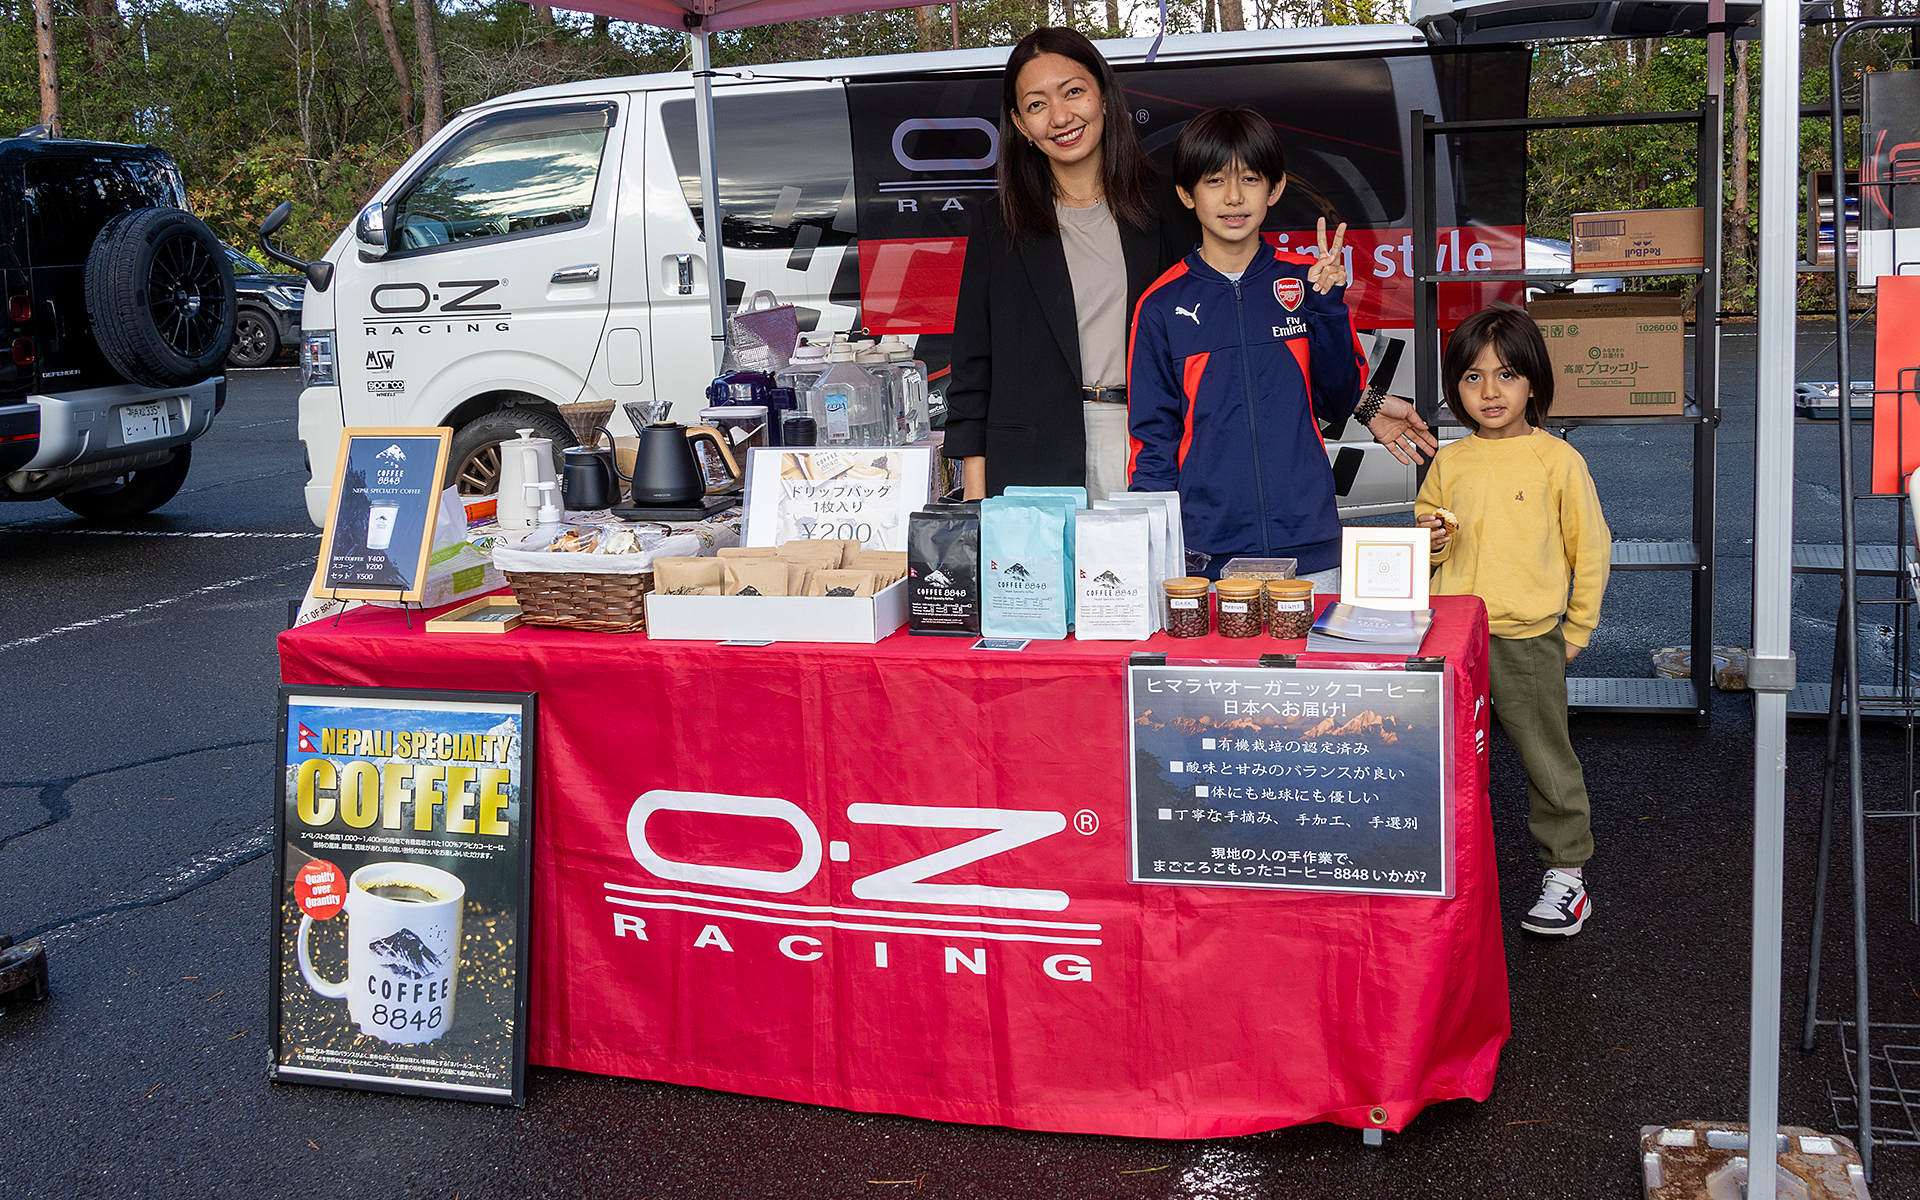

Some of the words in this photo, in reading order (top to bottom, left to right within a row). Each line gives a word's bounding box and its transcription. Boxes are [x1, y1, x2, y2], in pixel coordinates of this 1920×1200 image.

[1624, 248, 1642, 258] Bull
[1643, 247, 1661, 257] Red
[1286, 316, 1300, 325] Fly
[365, 323, 510, 336] RACING
[1272, 323, 1307, 337] Emirat
[365, 350, 395, 370] MSW
[42, 369, 81, 379] DEFENDER
[1563, 361, 1649, 375] 高原ブロッコリー
[368, 381, 404, 391] sparco
[377, 469, 404, 477] COFFEE
[377, 477, 401, 485] 8848
[792, 485, 892, 498] ドリップバッグ
[813, 501, 862, 513] 1枚入り
[801, 523, 872, 543] ¥200
[367, 555, 386, 563] ¥400
[330, 572, 351, 580] セット
[917, 588, 943, 596] COFFEE
[944, 589, 967, 597] 8848
[998, 581, 1022, 589] COFFEE
[1024, 581, 1047, 590] 8848
[1086, 589, 1112, 597] COFFEE
[1114, 588, 1138, 597] 8848
[310, 608, 321, 619] OF
[1146, 676, 1426, 700] ヒマラヤオーガニックコーヒー
[1223, 699, 1348, 718] 日本へお届け!
[321, 727, 394, 758] NEPALI
[396, 731, 513, 763] SPECIALTY
[1217, 737, 1370, 756] 有機栽培の認定済み
[1185, 761, 1406, 781] 酸味と甘みのバランスが良い
[297, 758, 511, 836] COFFEE
[1210, 784, 1380, 805] 体にも地球にも優しい
[1295, 812, 1353, 829] 手加工、
[1368, 815, 1419, 831] 手選別
[1211, 847, 1357, 867] 現地の人の手作業で、
[304, 871, 335, 886] Quality
[1152, 859, 1369, 883] まごころこもったコーヒー8848
[1372, 868, 1427, 884] いかが?
[311, 884, 331, 896] over
[304, 894, 341, 909] Quantity
[612, 912, 1093, 982] RACING
[367, 974, 449, 1004] COFFEE
[372, 1004, 443, 1032] 8848
